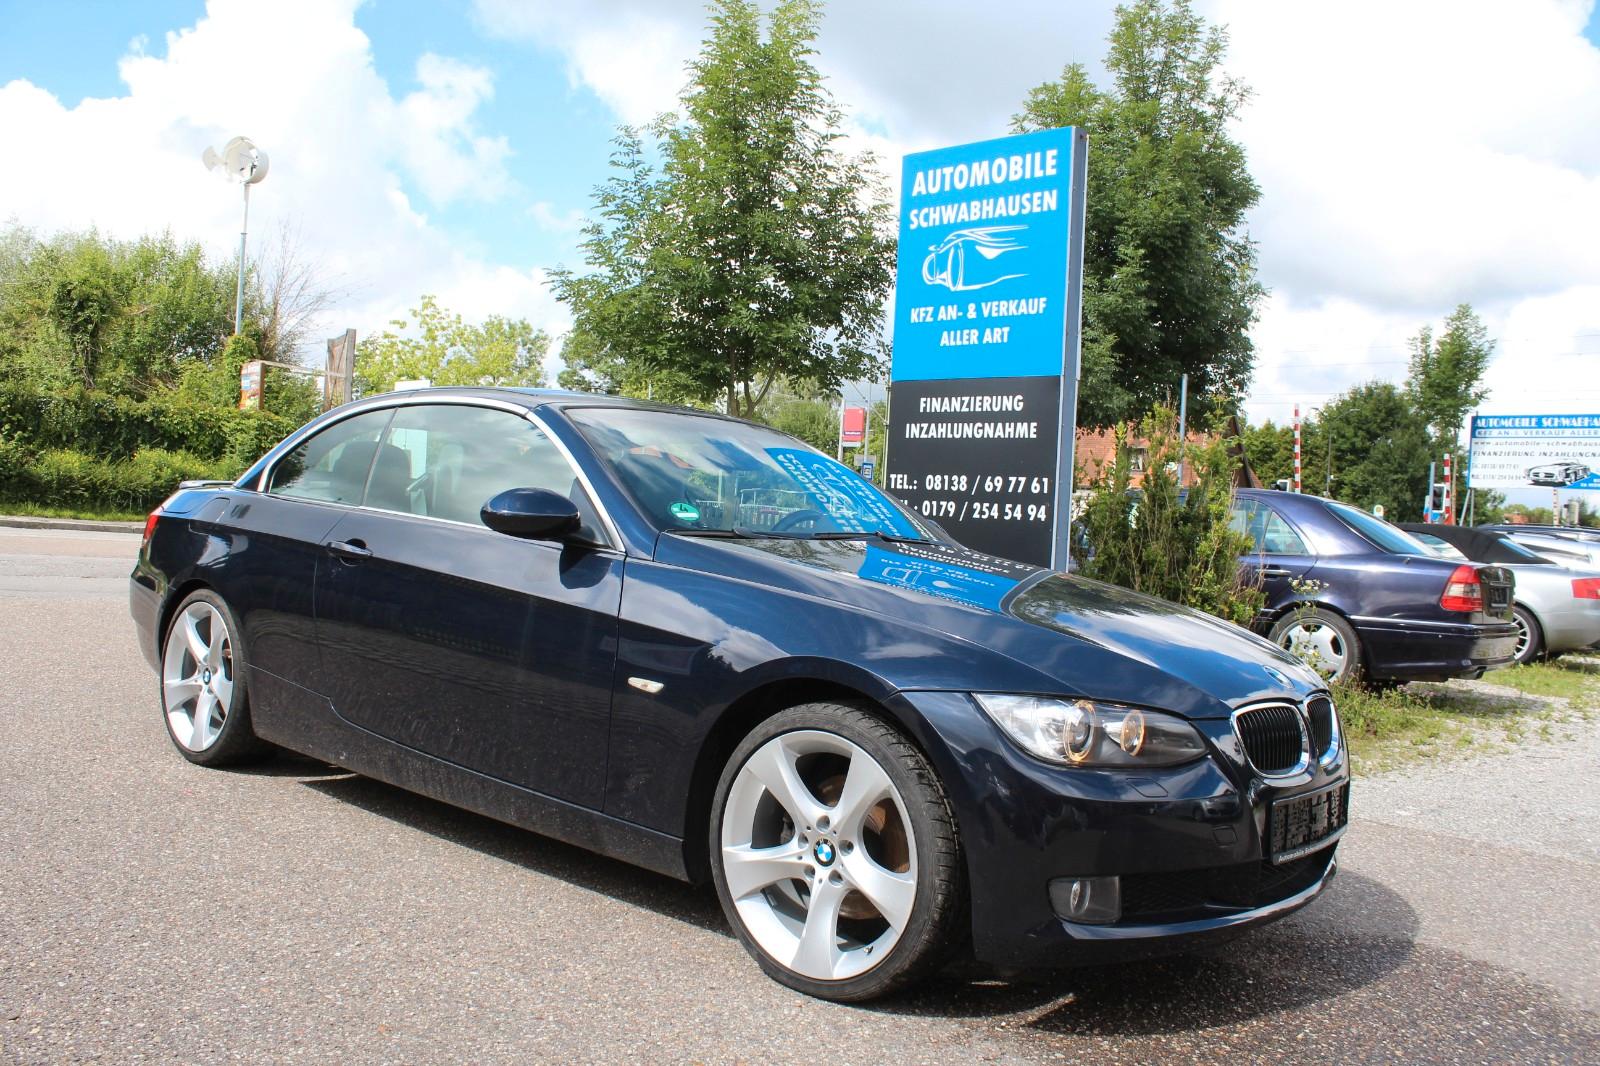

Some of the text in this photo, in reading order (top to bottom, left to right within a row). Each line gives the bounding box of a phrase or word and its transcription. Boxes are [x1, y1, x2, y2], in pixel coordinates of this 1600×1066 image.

[913, 150, 1057, 197] AUTOMOBILE
[910, 190, 1057, 229] SCHWABHAUSEN
[910, 297, 1047, 324] KFZ AN- & VERKAUF
[940, 327, 1010, 347] ALLER ART
[919, 395, 1024, 413] FINANZIERUNG
[905, 422, 1038, 439] INZAHLUNGNAHME
[890, 474, 1049, 495] TEL.: 08138 / 69 77 61
[922, 500, 956, 517] 0179
[959, 501, 968, 522] /
[972, 502, 999, 520] 254
[1004, 504, 1023, 520] 54
[1027, 504, 1047, 522] 94
